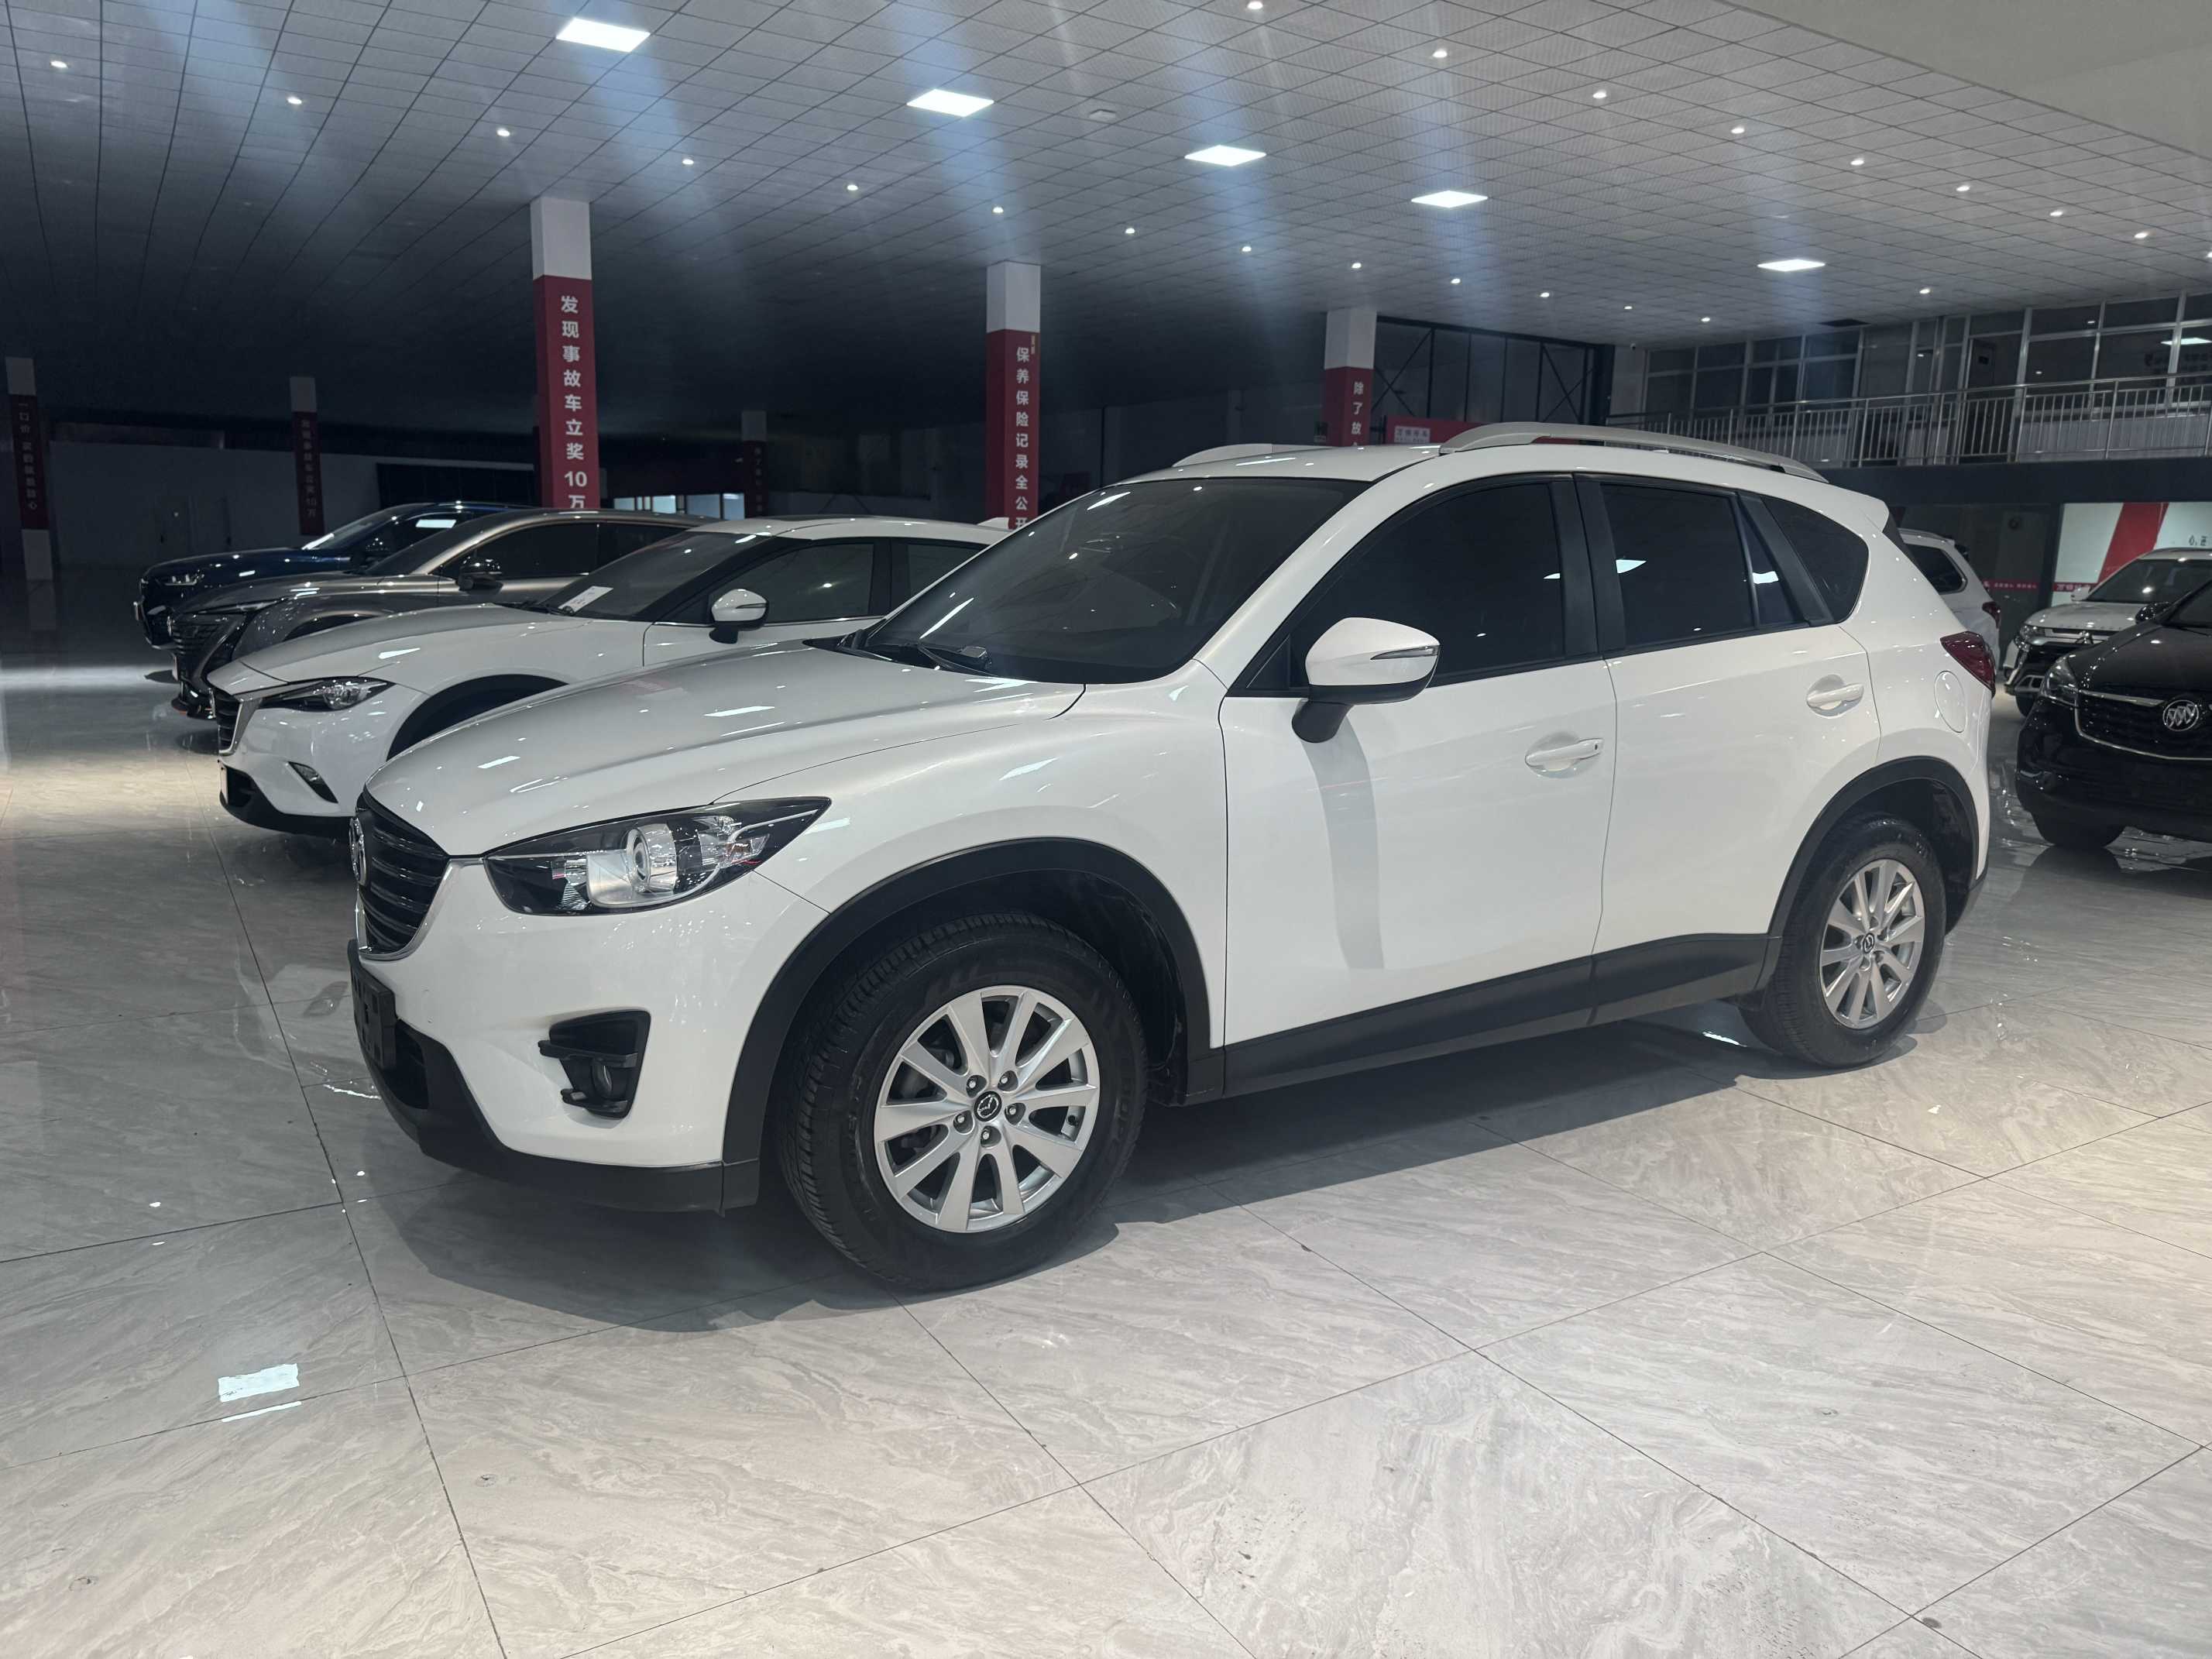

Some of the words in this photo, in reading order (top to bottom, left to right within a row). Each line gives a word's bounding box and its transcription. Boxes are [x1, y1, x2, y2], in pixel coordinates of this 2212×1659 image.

[561, 295, 587, 509] 发现事故车立奖10万
